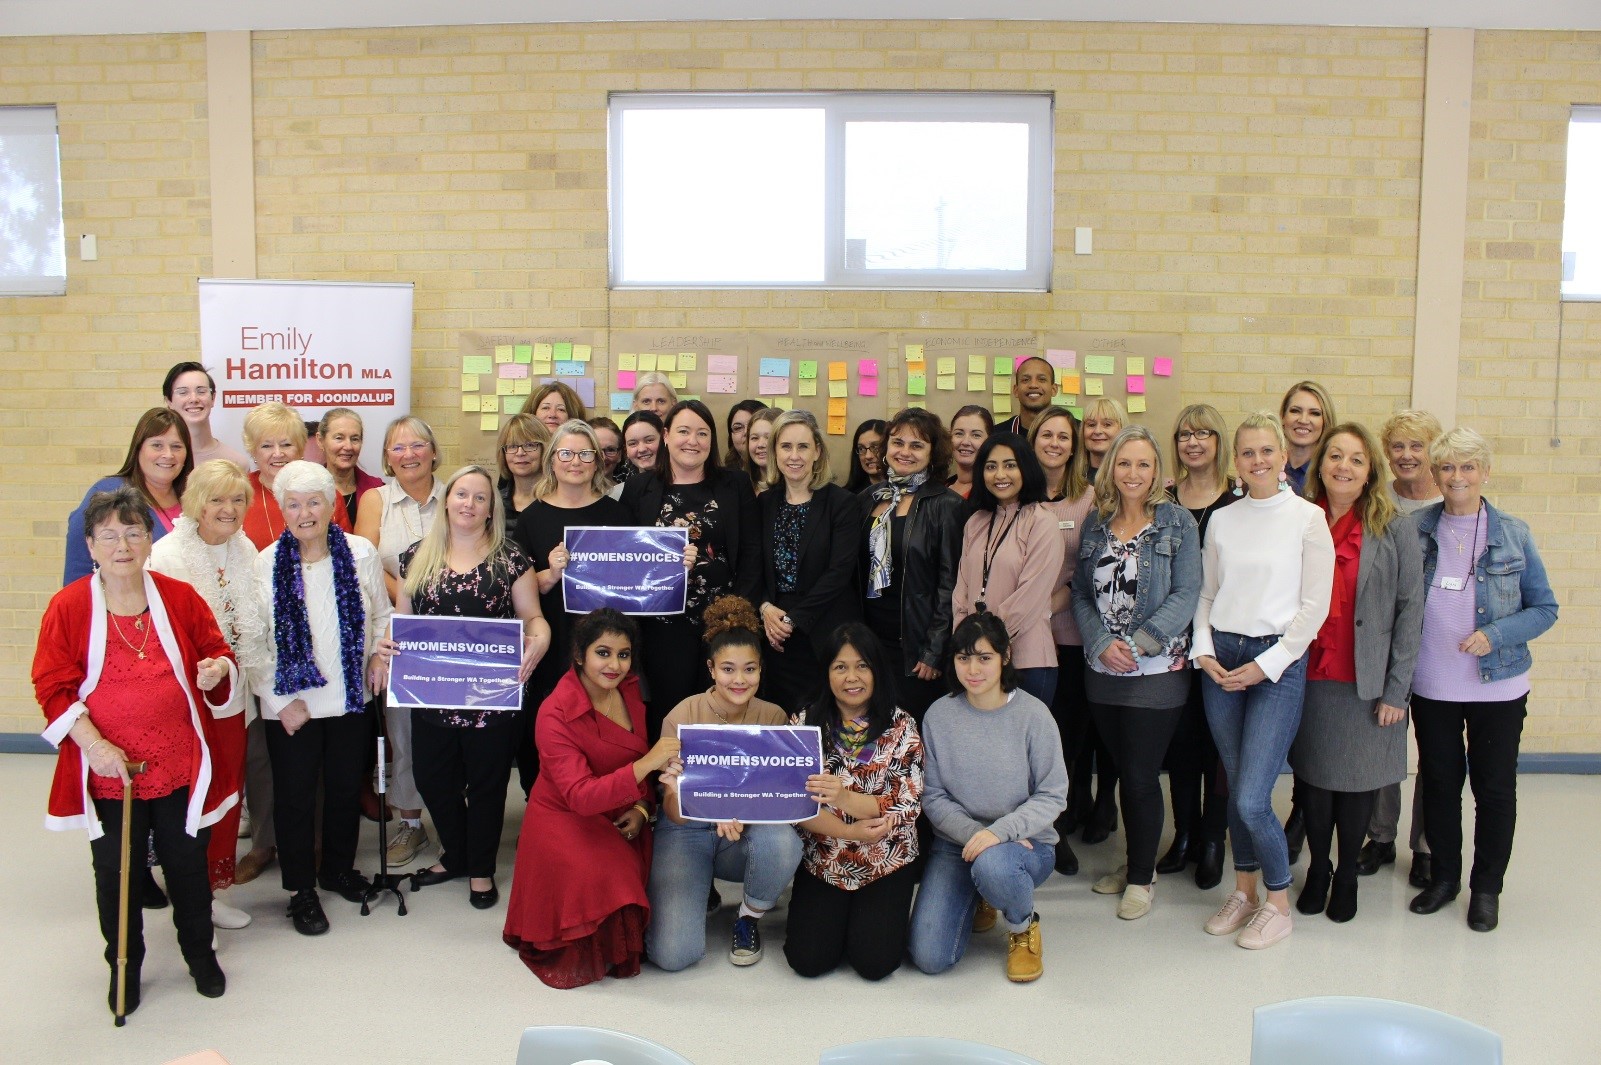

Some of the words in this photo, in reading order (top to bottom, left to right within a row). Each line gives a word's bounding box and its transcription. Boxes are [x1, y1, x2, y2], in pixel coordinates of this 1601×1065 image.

[241, 326, 313, 356] Emily
[652, 336, 722, 348] LEADERSHIP
[925, 337, 970, 347] ECONOMIC
[974, 336, 1038, 348] INDEPENDENCE
[1092, 338, 1127, 349] OTHER
[226, 357, 353, 380] Hamilton
[361, 368, 392, 379] MLA
[224, 394, 283, 404] MEMBER
[287, 393, 313, 403] FOR
[316, 393, 393, 403] JOONDALUP
[570, 552, 680, 562] #WOMENSVOICES
[399, 640, 515, 654] #WOMENSVOICES
[403, 674, 430, 682] Building
[686, 754, 814, 767] #WOMENSVOICES
[693, 791, 722, 799] Building
